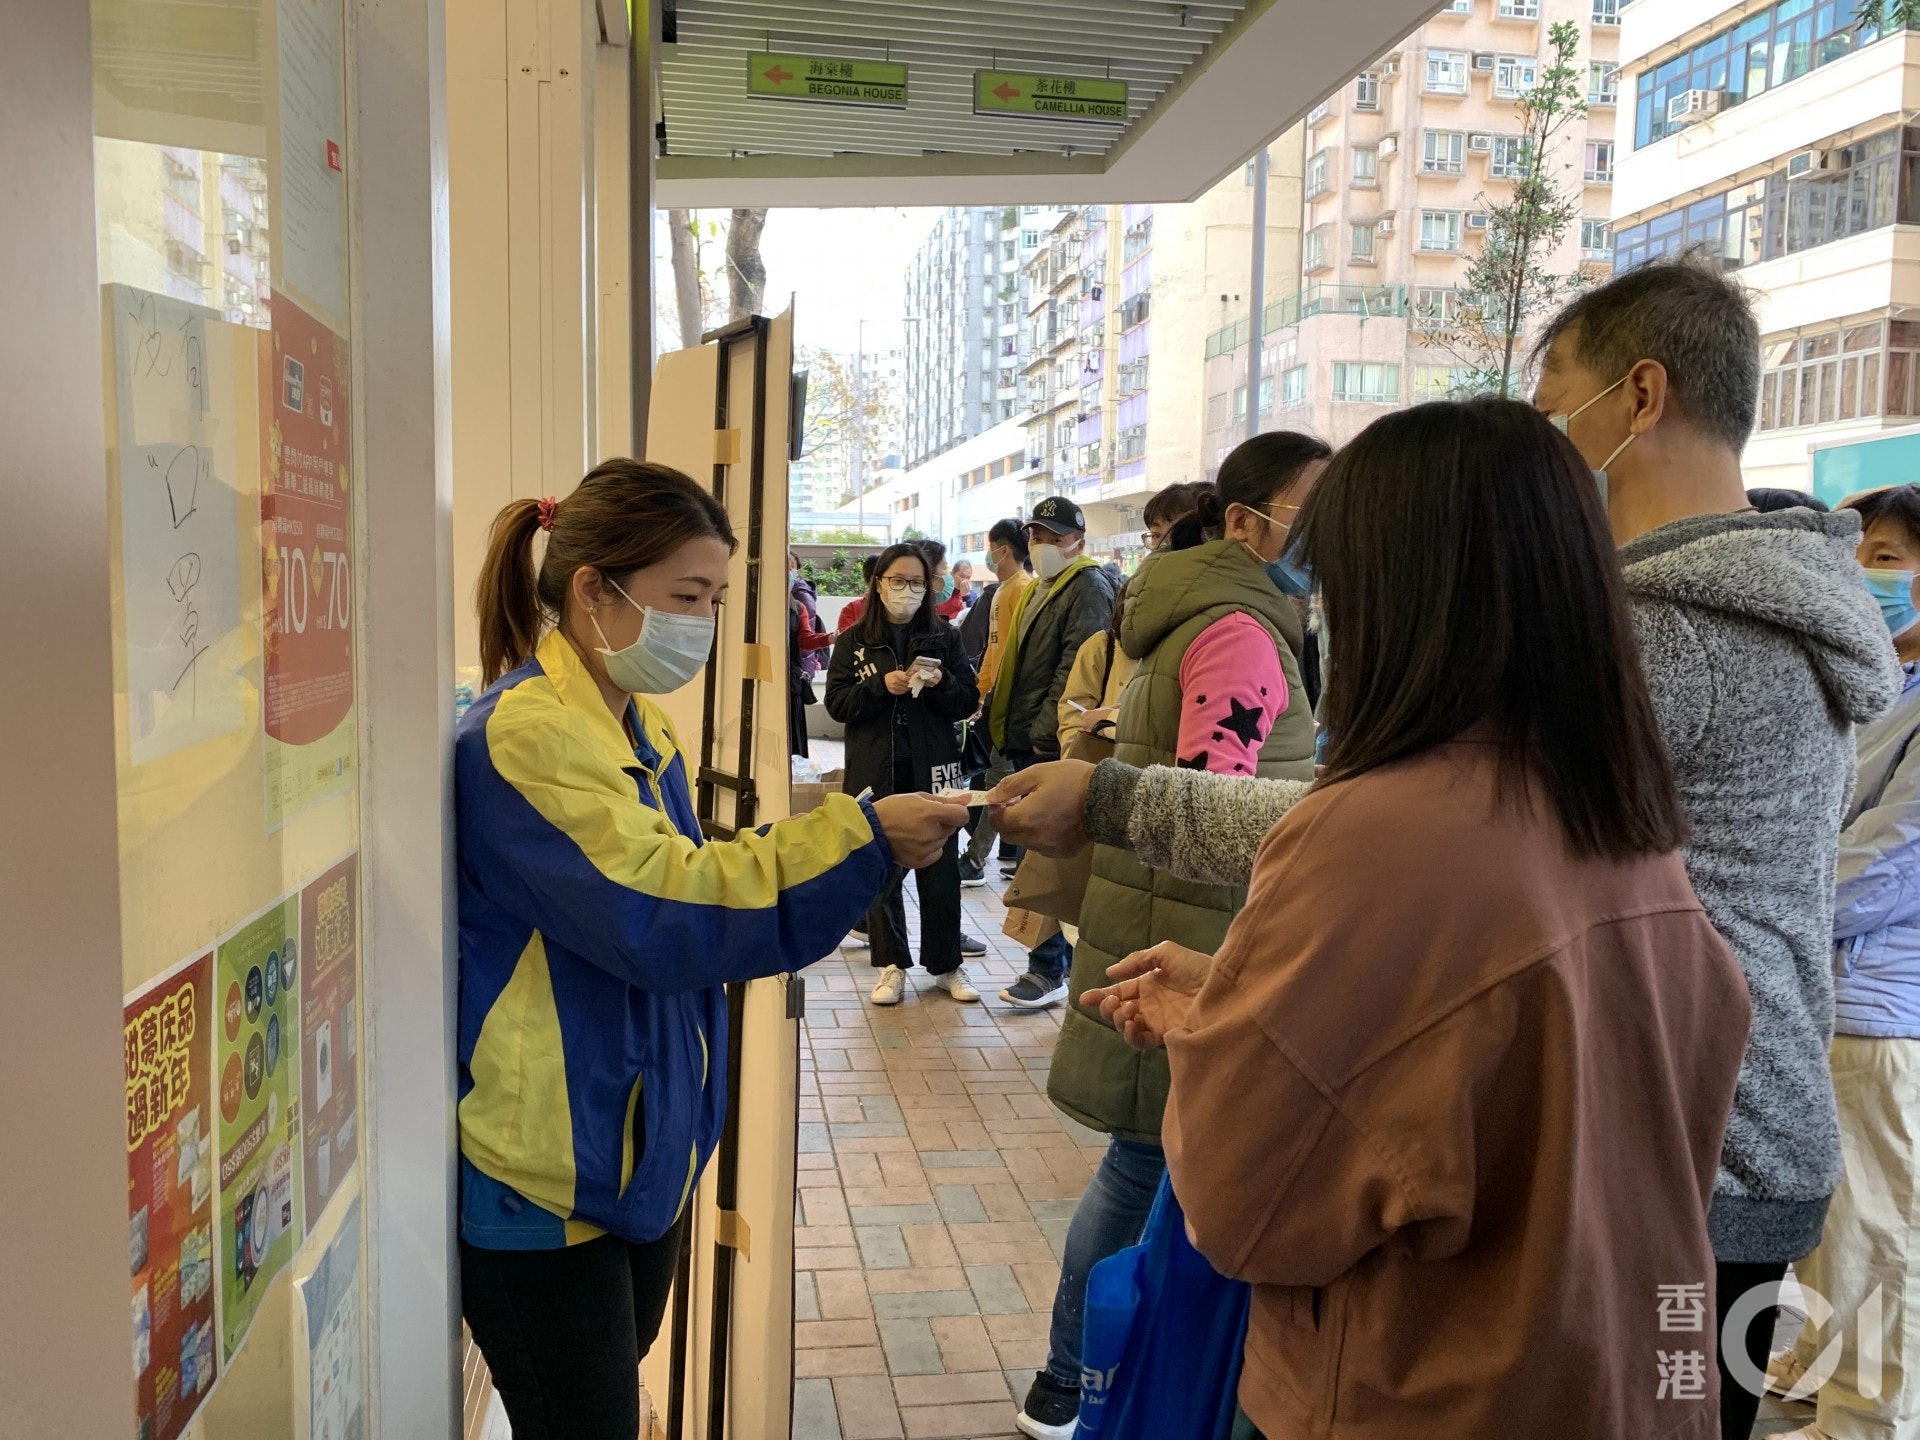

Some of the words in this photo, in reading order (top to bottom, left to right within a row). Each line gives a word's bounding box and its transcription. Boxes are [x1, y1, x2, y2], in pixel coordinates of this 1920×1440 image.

[809, 61, 853, 78] 海棠樓
[808, 83, 860, 97] BEGONIA
[863, 87, 902, 100] HOUSE
[1036, 78, 1076, 95] 茶花樓
[1034, 100, 1085, 114] CAMELLIA
[1088, 104, 1122, 117] HOUSE
[280, 546, 308, 634] 10
[323, 551, 349, 630] 70
[127, 1048, 190, 1151] 過新年
